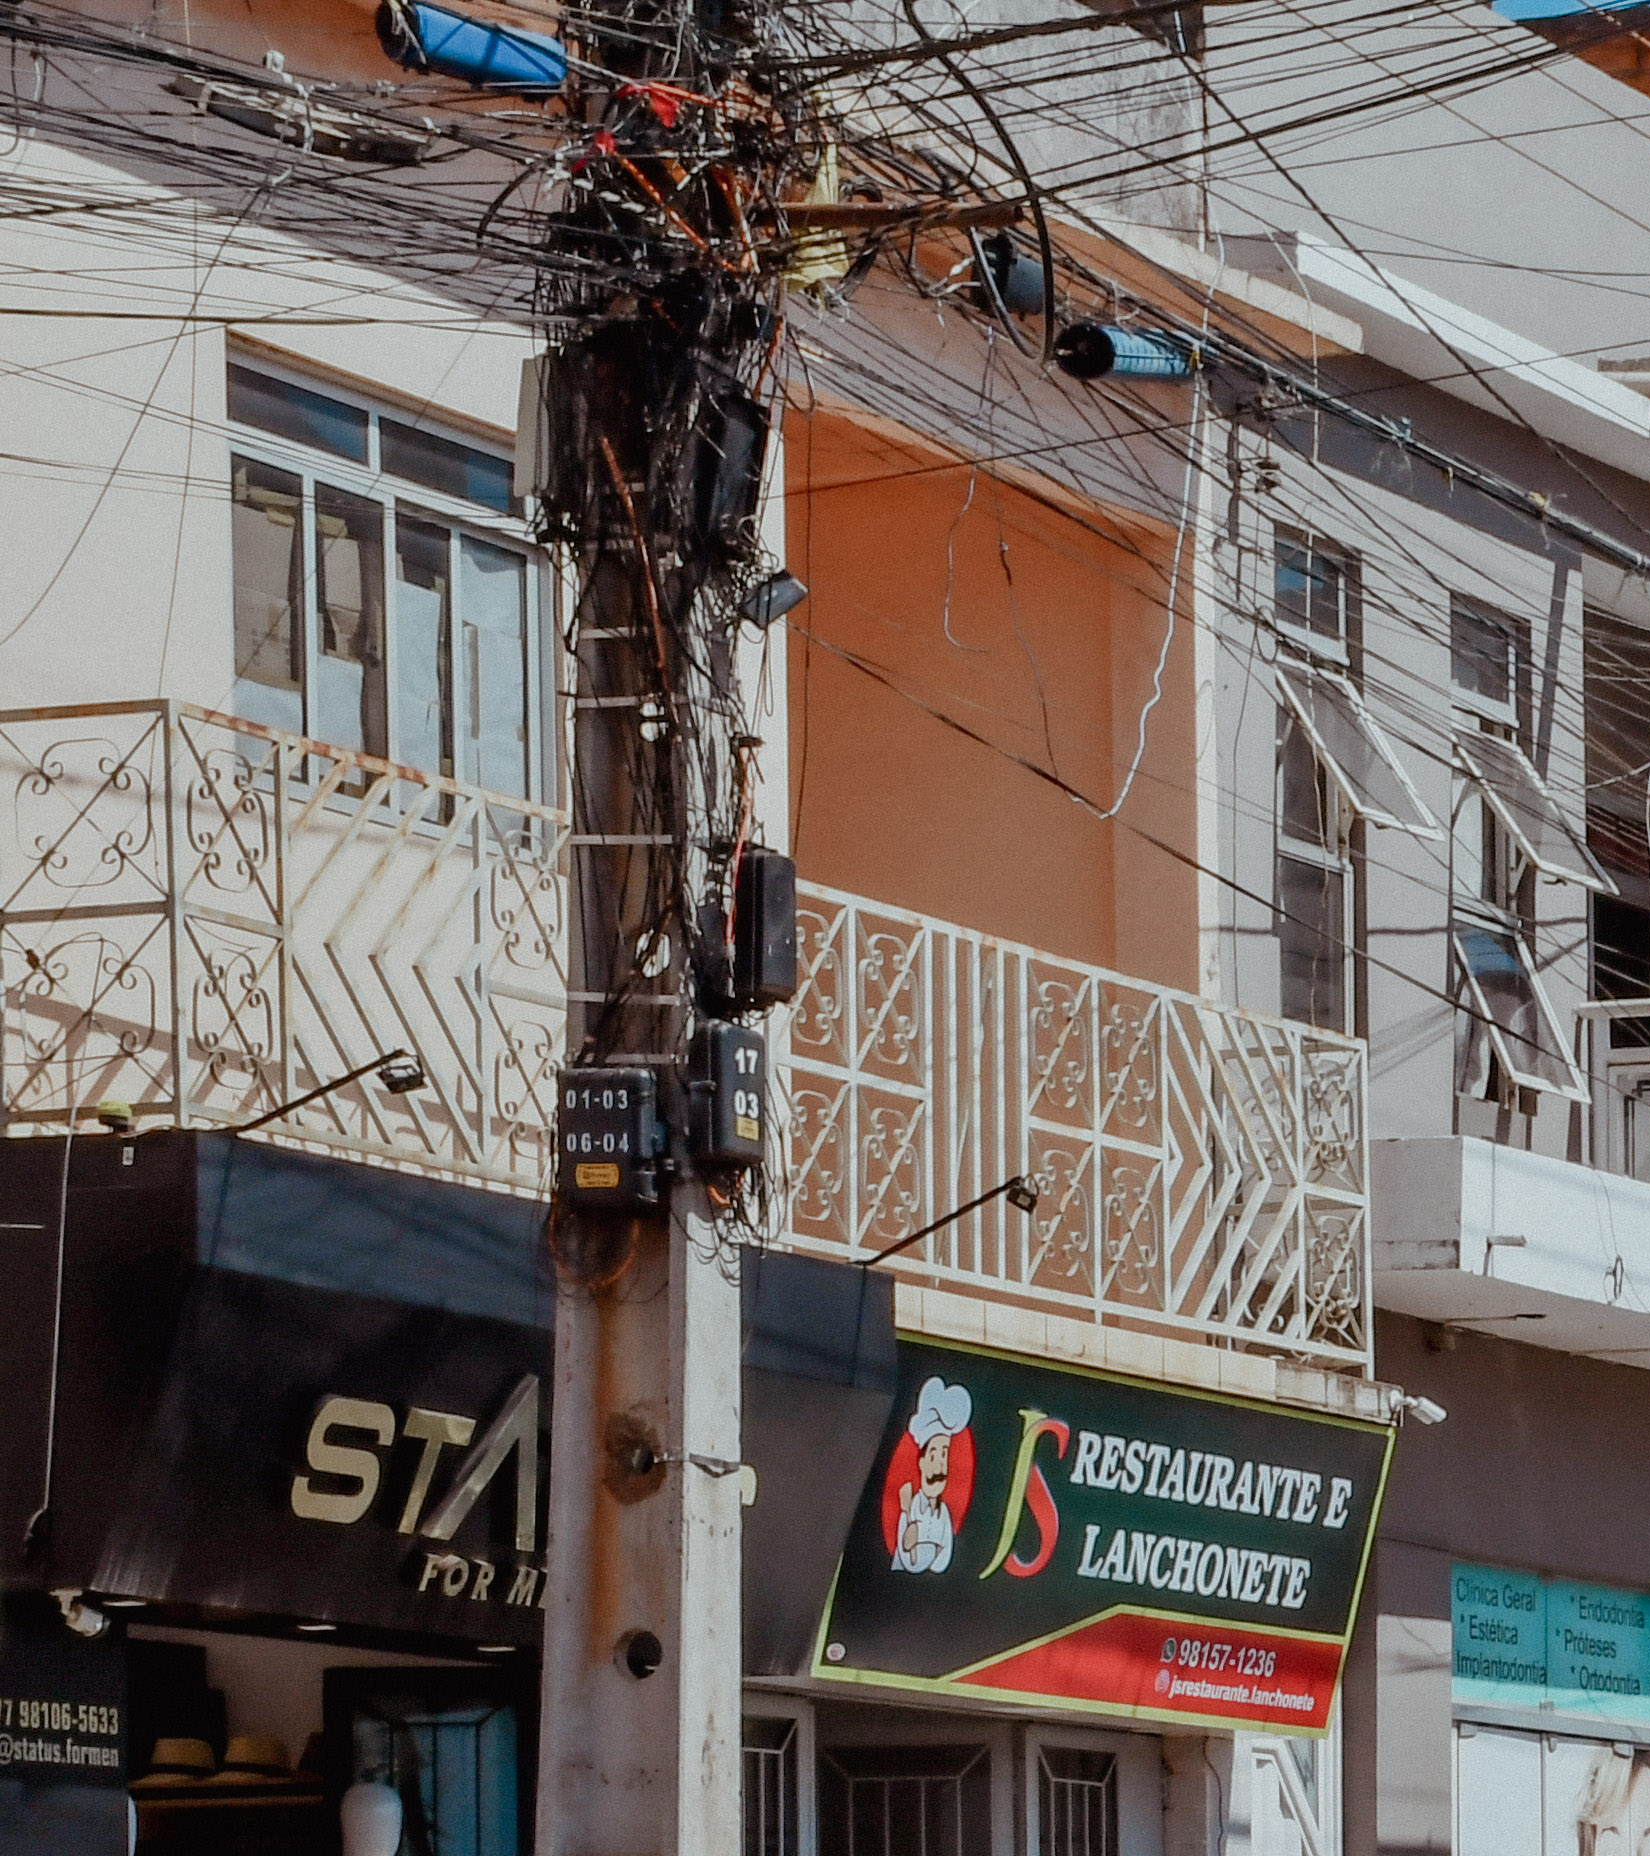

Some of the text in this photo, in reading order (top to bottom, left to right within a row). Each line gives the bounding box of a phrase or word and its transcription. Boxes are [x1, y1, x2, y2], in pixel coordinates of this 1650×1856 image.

[734, 1047, 758, 1074] 17
[565, 1089, 629, 1109] 01-03
[734, 1089, 759, 1118] 03
[566, 1132, 629, 1153] 06-04
[1070, 1430, 1321, 1524] RESTAURANTE
[1323, 1477, 1353, 1529] E
[418, 1554, 496, 1602] FOR
[1076, 1525, 1312, 1609] LANCHONETE
[1502, 1584, 1536, 1612] Geral
[1178, 1639, 1276, 1678] 98157-1236
[1168, 1675, 1315, 1711] jsrestaurante.lanchonete
[20, 1700, 118, 1735] 98106-5633
[0, 1733, 119, 1767] @status.formen
